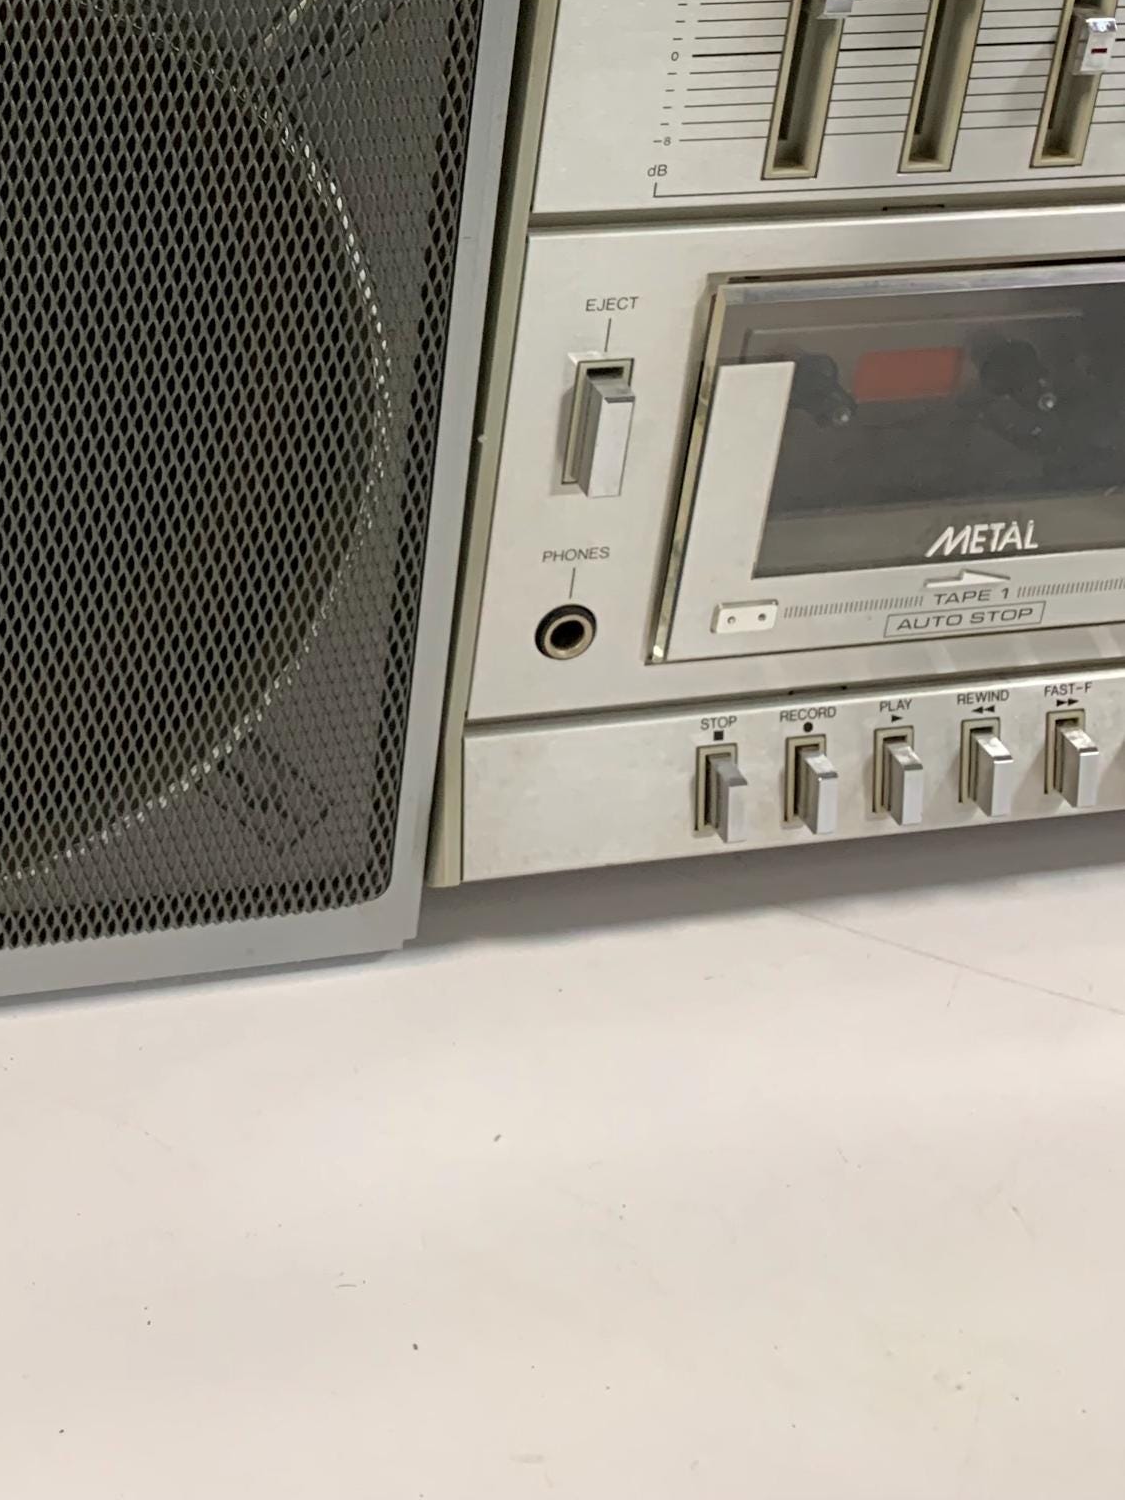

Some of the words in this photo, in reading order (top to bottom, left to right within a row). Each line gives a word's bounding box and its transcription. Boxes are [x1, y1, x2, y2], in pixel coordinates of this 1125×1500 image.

[647, 163, 668, 178] dB
[585, 295, 640, 312] EJECT
[925, 519, 1039, 558] METAL
[541, 546, 610, 563] PHONES
[934, 589, 993, 605] TAPE
[896, 614, 963, 631] AUTO
[969, 607, 1034, 624] STOP
[956, 690, 1010, 705] REWIND
[1043, 681, 1093, 698] FAST-F
[879, 698, 913, 713] PLAY
[779, 706, 837, 722] RECORD
[700, 716, 738, 730] STOP
